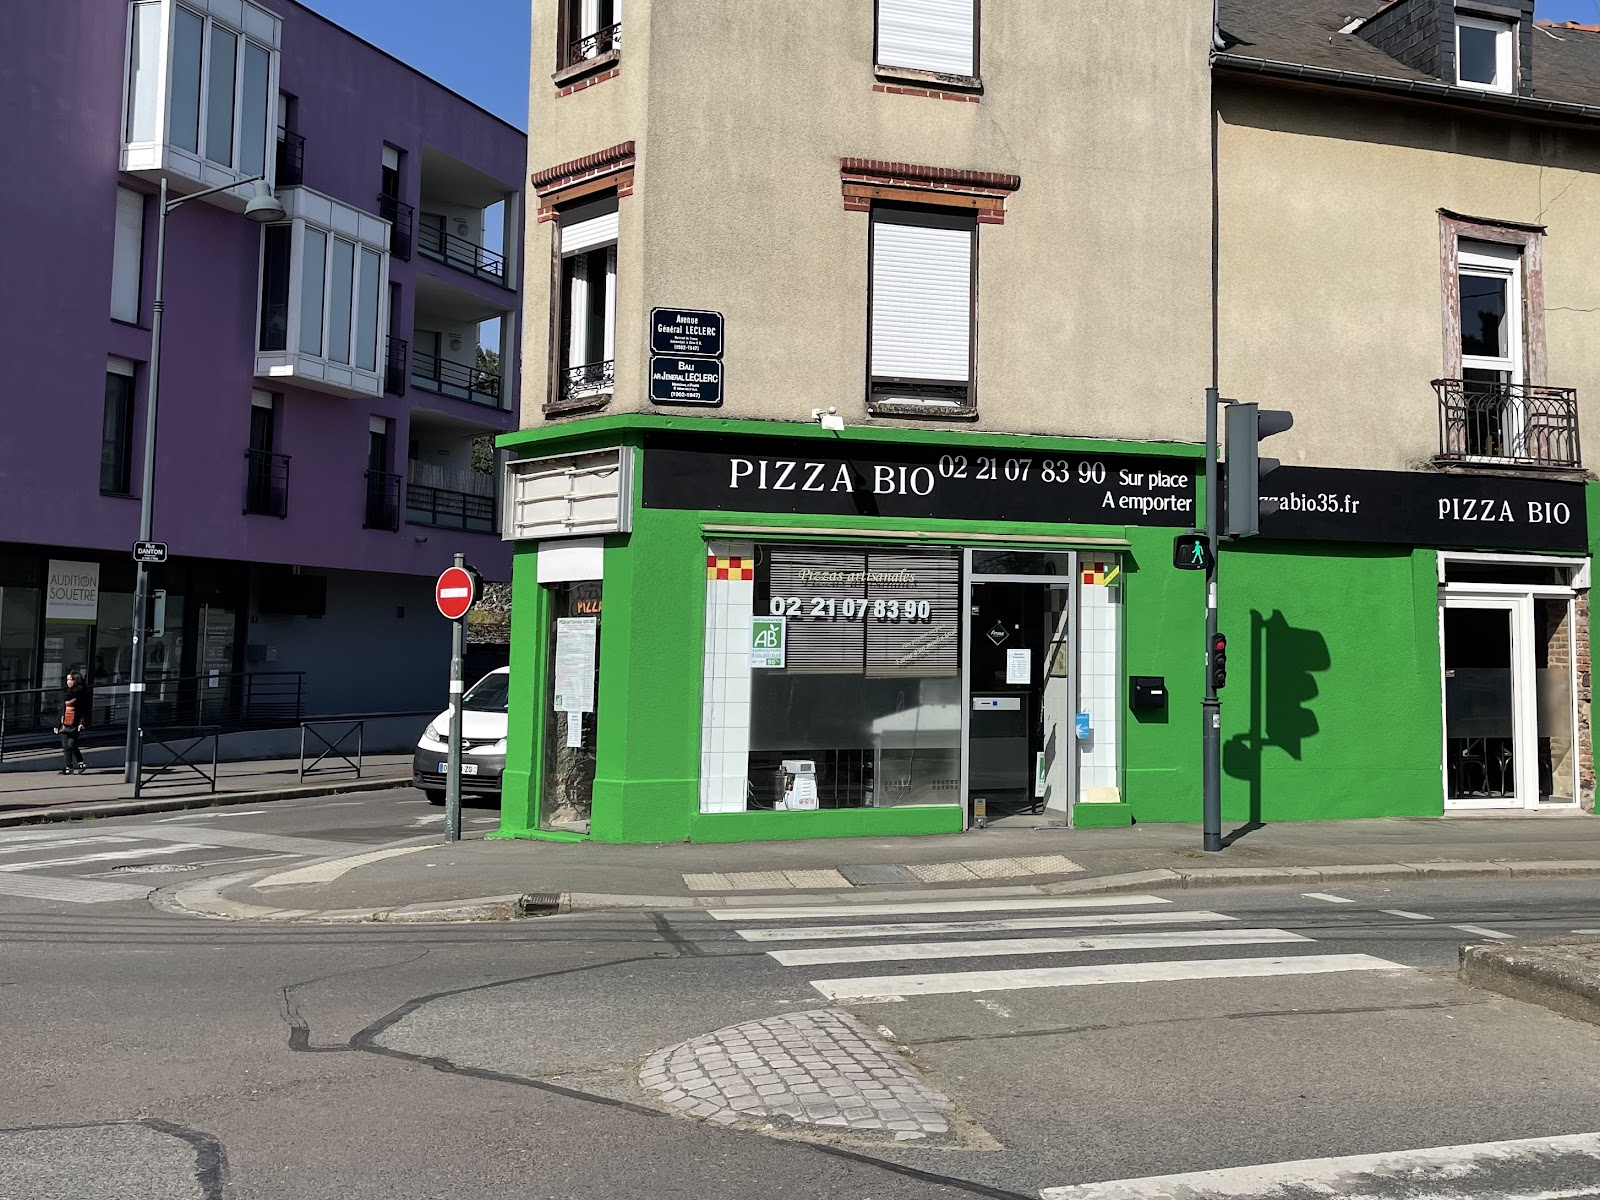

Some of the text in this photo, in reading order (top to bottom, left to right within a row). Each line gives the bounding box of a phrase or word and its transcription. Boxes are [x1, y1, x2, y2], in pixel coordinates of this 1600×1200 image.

[676, 314, 699, 324] Avenue
[657, 324, 716, 336] Général LECLERC
[685, 373, 719, 383] LECLERC
[729, 458, 935, 496] PIZZA BIO
[938, 454, 1106, 485] 02 21 07 83 90
[1119, 469, 1189, 490] Sur place
[1102, 491, 1192, 515] A emporter
[1527, 501, 1571, 525] BIO
[50, 573, 97, 587] AUDITION
[799, 568, 915, 583] Pizzas artisanales
[49, 587, 96, 601] SOUETRE
[770, 596, 930, 619] 02 21 07 83 90
[754, 629, 778, 648] AB
